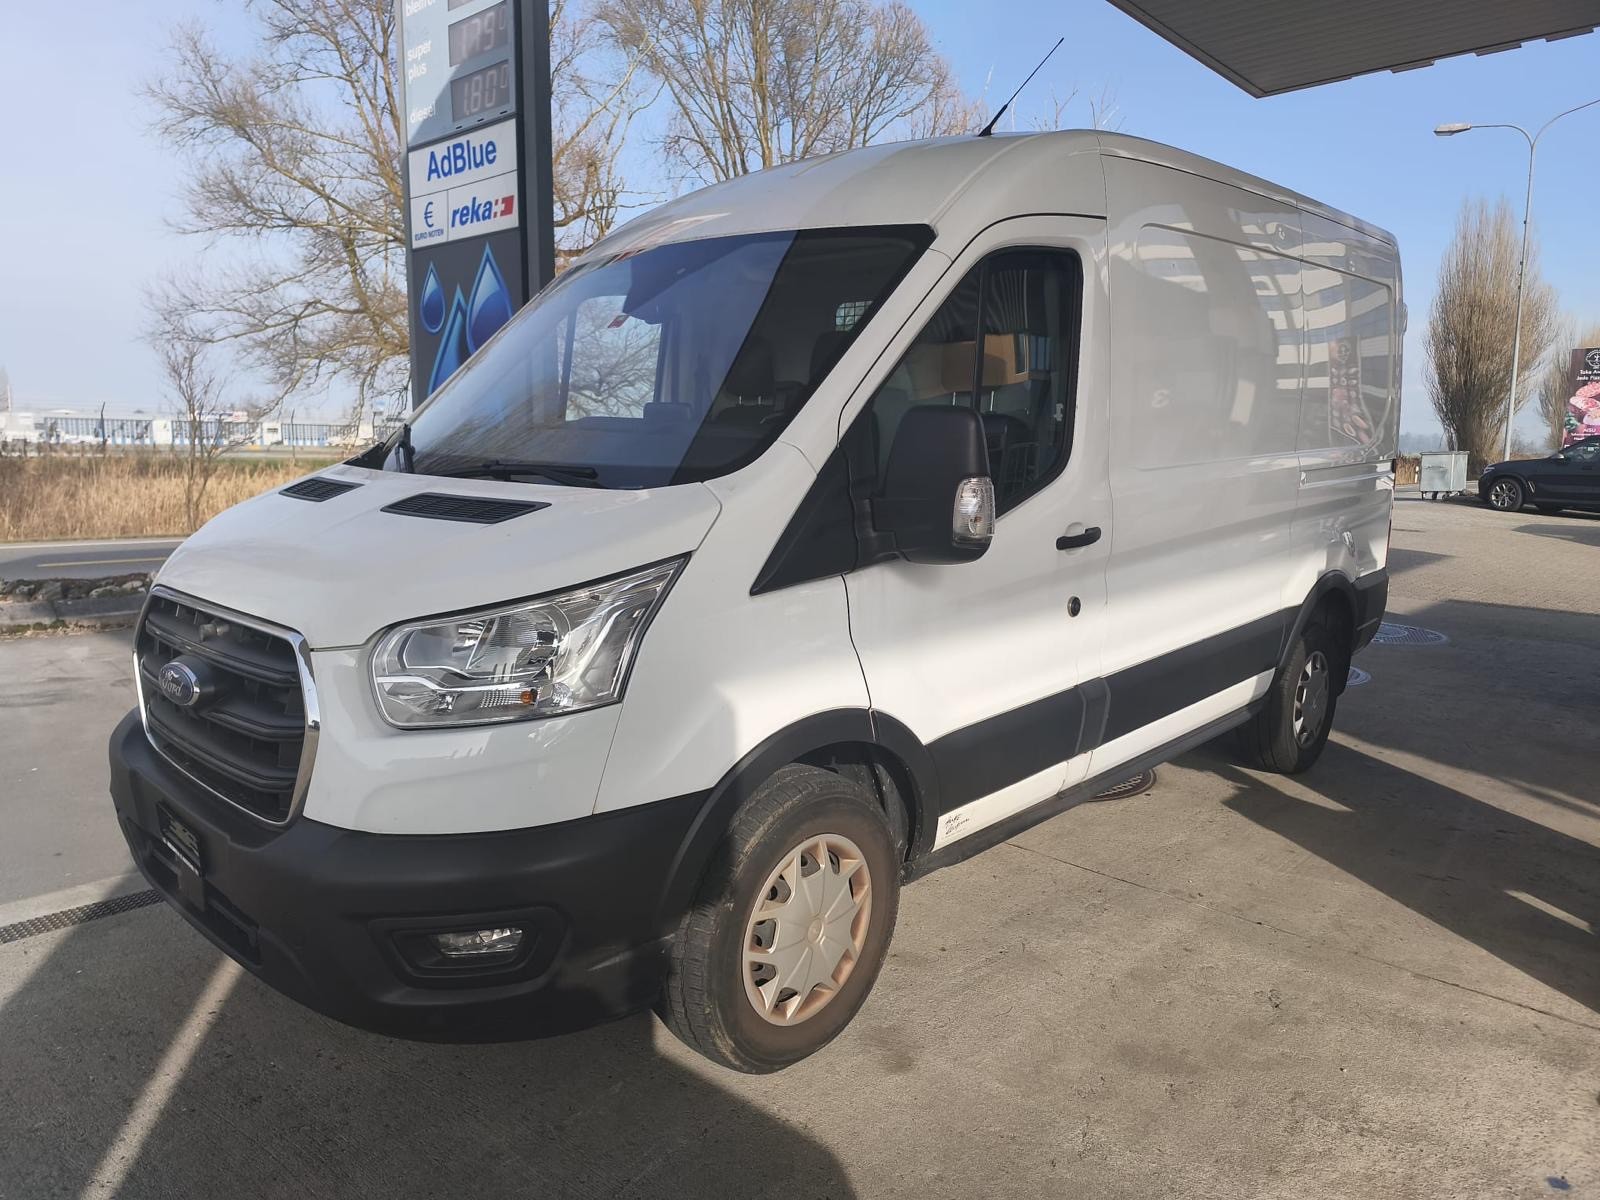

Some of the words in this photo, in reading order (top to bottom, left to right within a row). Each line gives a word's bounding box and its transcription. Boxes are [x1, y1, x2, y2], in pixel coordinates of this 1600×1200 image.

[407, 40, 431, 62] super
[408, 63, 427, 84] plus
[427, 140, 497, 182] AdBlue
[161, 670, 184, 697] Ford
